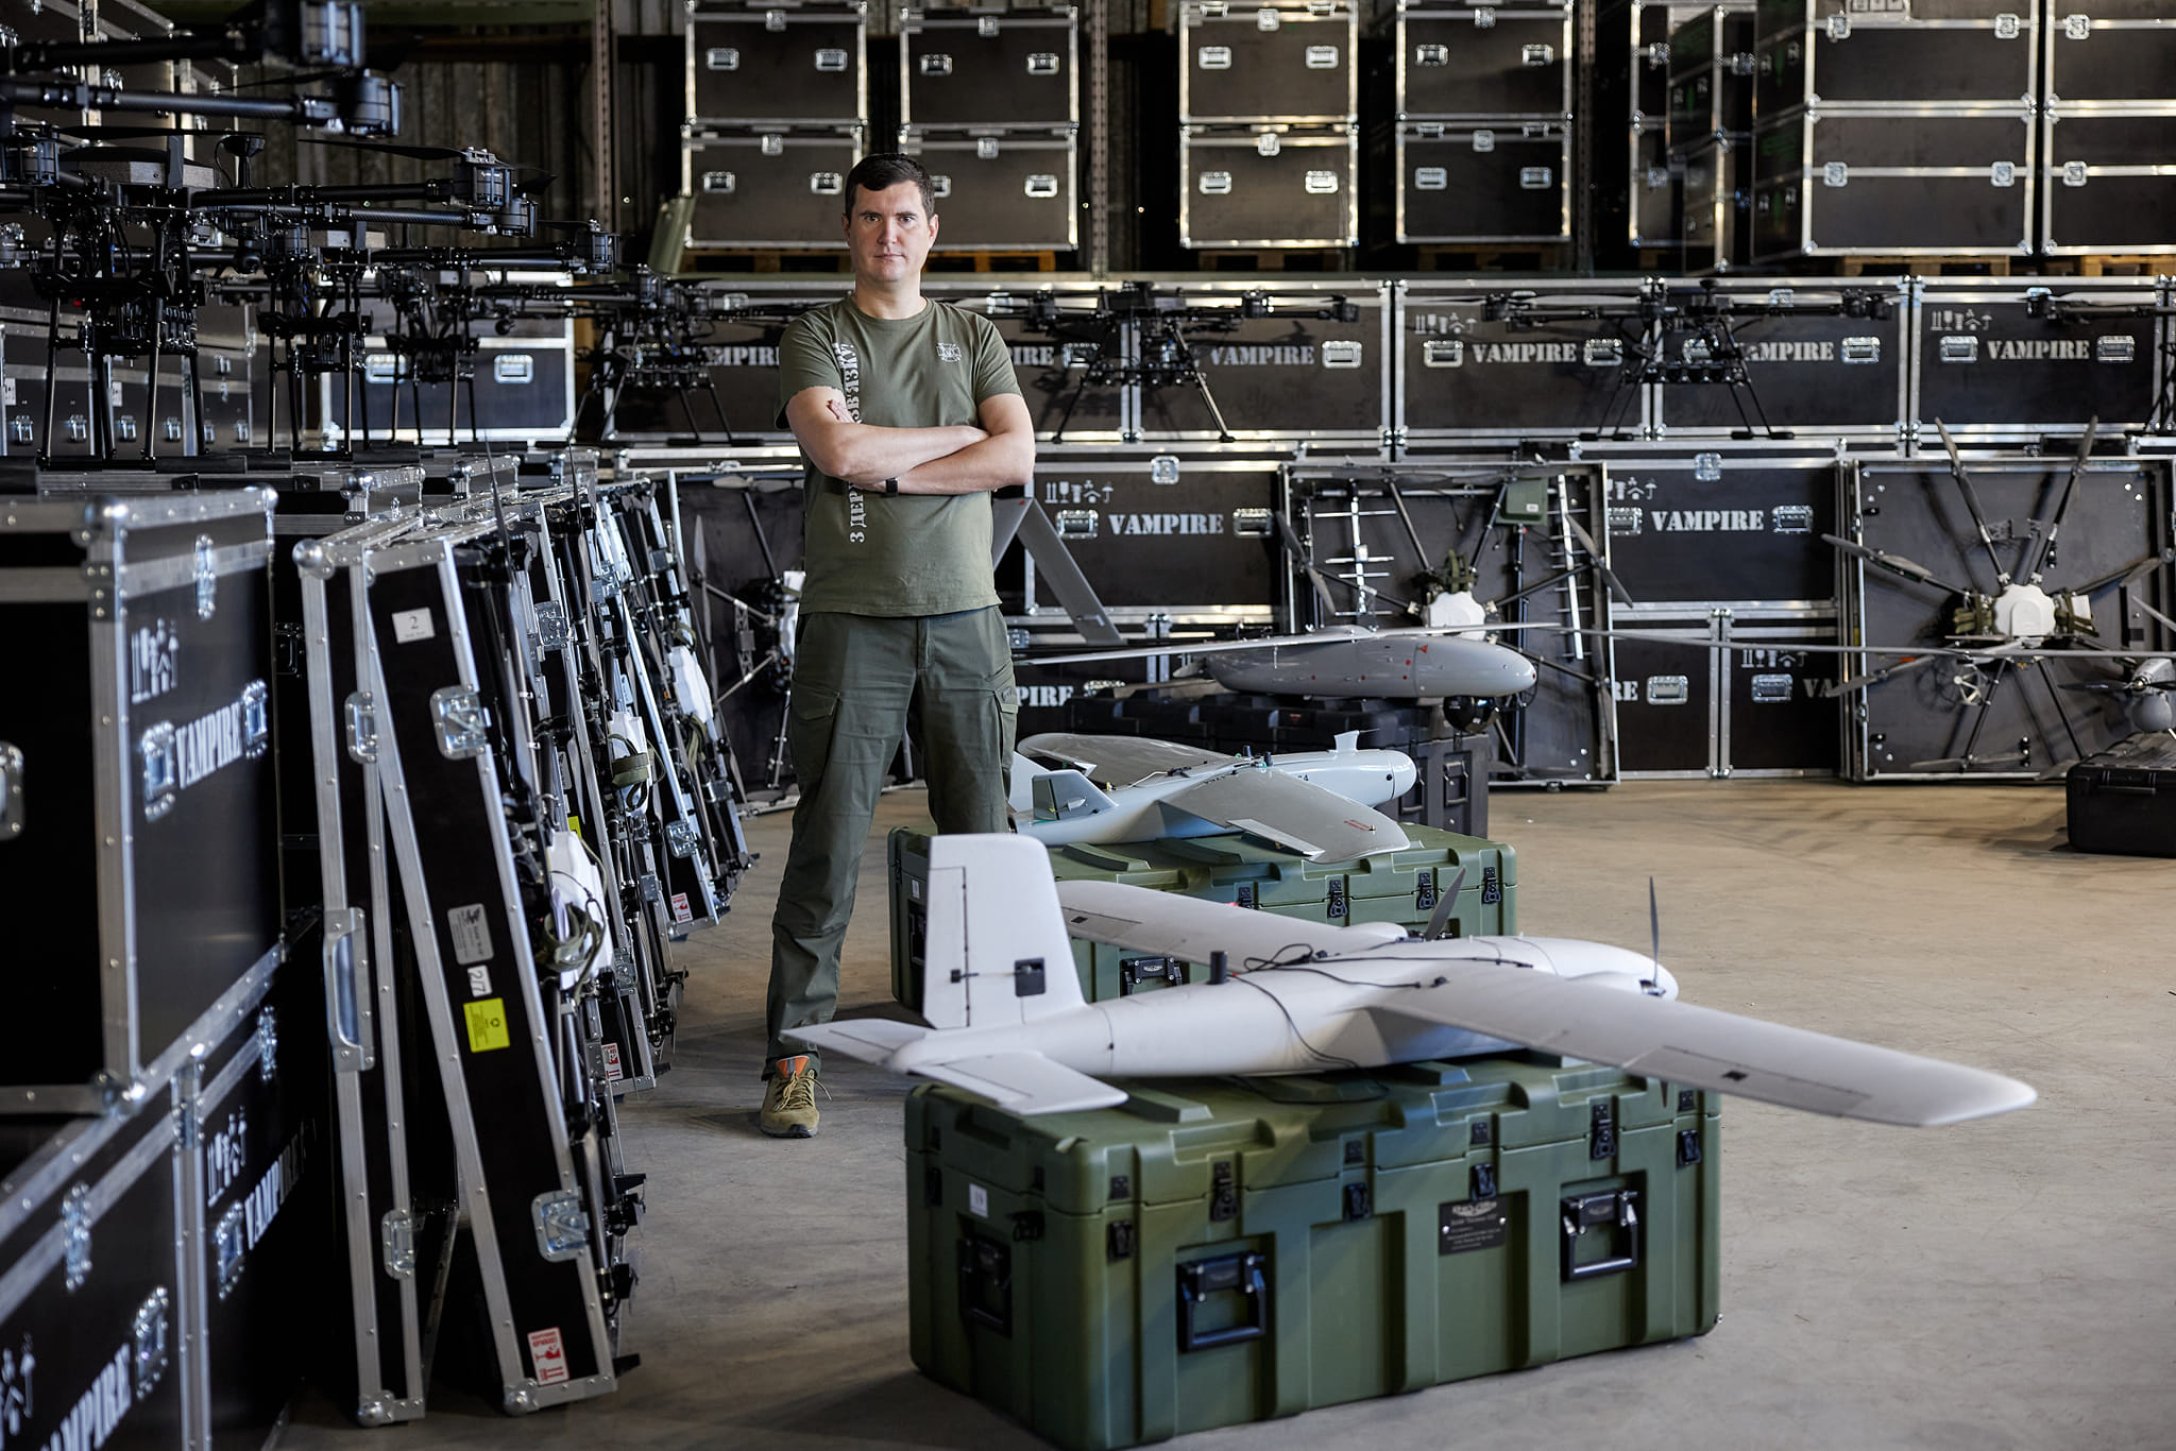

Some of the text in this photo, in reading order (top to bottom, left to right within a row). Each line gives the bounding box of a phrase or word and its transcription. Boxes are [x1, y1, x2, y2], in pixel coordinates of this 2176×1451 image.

[1210, 346, 1315, 366] VAMPIRE
[1472, 343, 1577, 364] VAMPIRE
[1735, 342, 1834, 361] AMPIRE
[1987, 340, 2090, 360] VAMPIRE
[1108, 513, 1223, 535] VAMPIRE
[1652, 510, 1764, 531] VAMPIRE
[1016, 685, 1074, 707] PIRE
[174, 701, 243, 789] VAMPIRE
[244, 1134, 299, 1250] VAMPIRE
